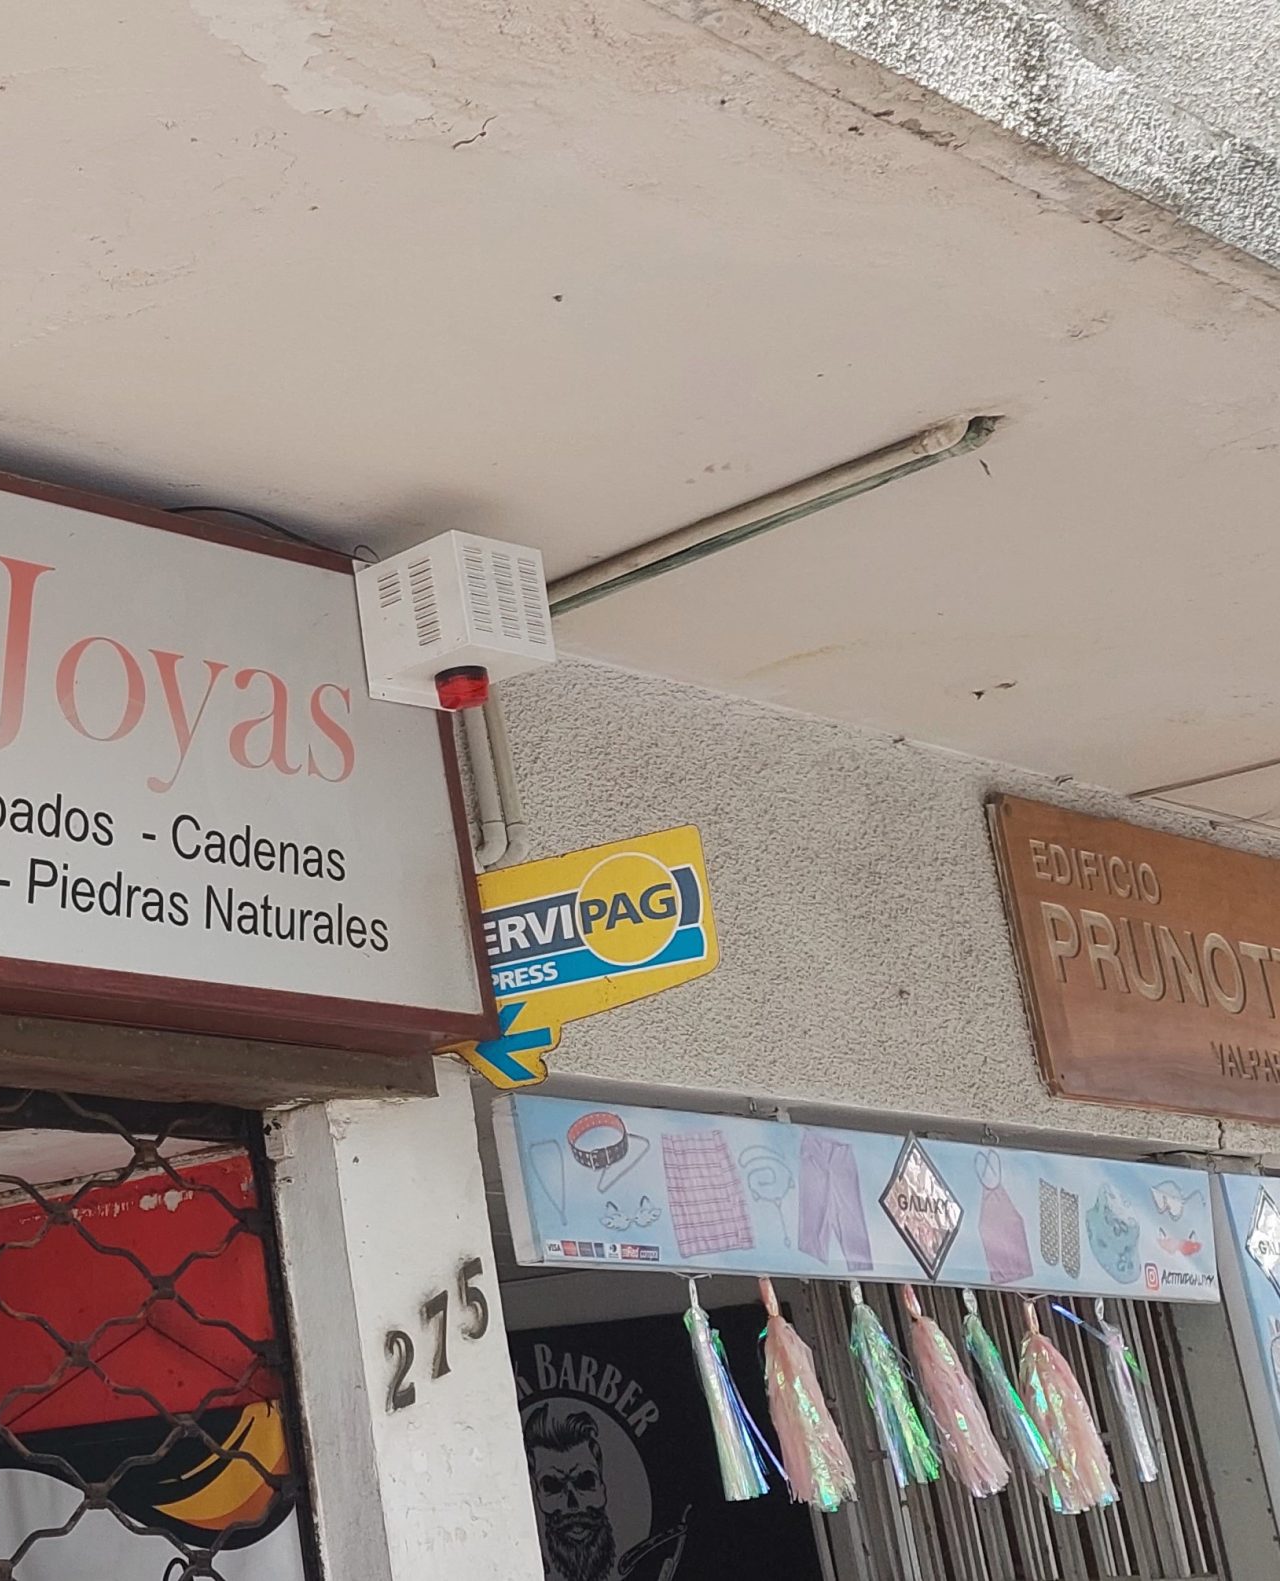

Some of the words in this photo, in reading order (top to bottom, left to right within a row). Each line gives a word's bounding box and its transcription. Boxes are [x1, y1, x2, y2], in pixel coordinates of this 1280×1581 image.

[171, 815, 347, 882] Cadenas
[1029, 839, 1162, 905] EDIFICIO
[27, 862, 190, 928] Piedras
[205, 885, 390, 954] Naturales
[483, 882, 678, 956] ERVIPAG
[897, 1193, 950, 1216] GALAXY
[384, 1257, 489, 1413] 275
[534, 1343, 660, 1438] BARBER
